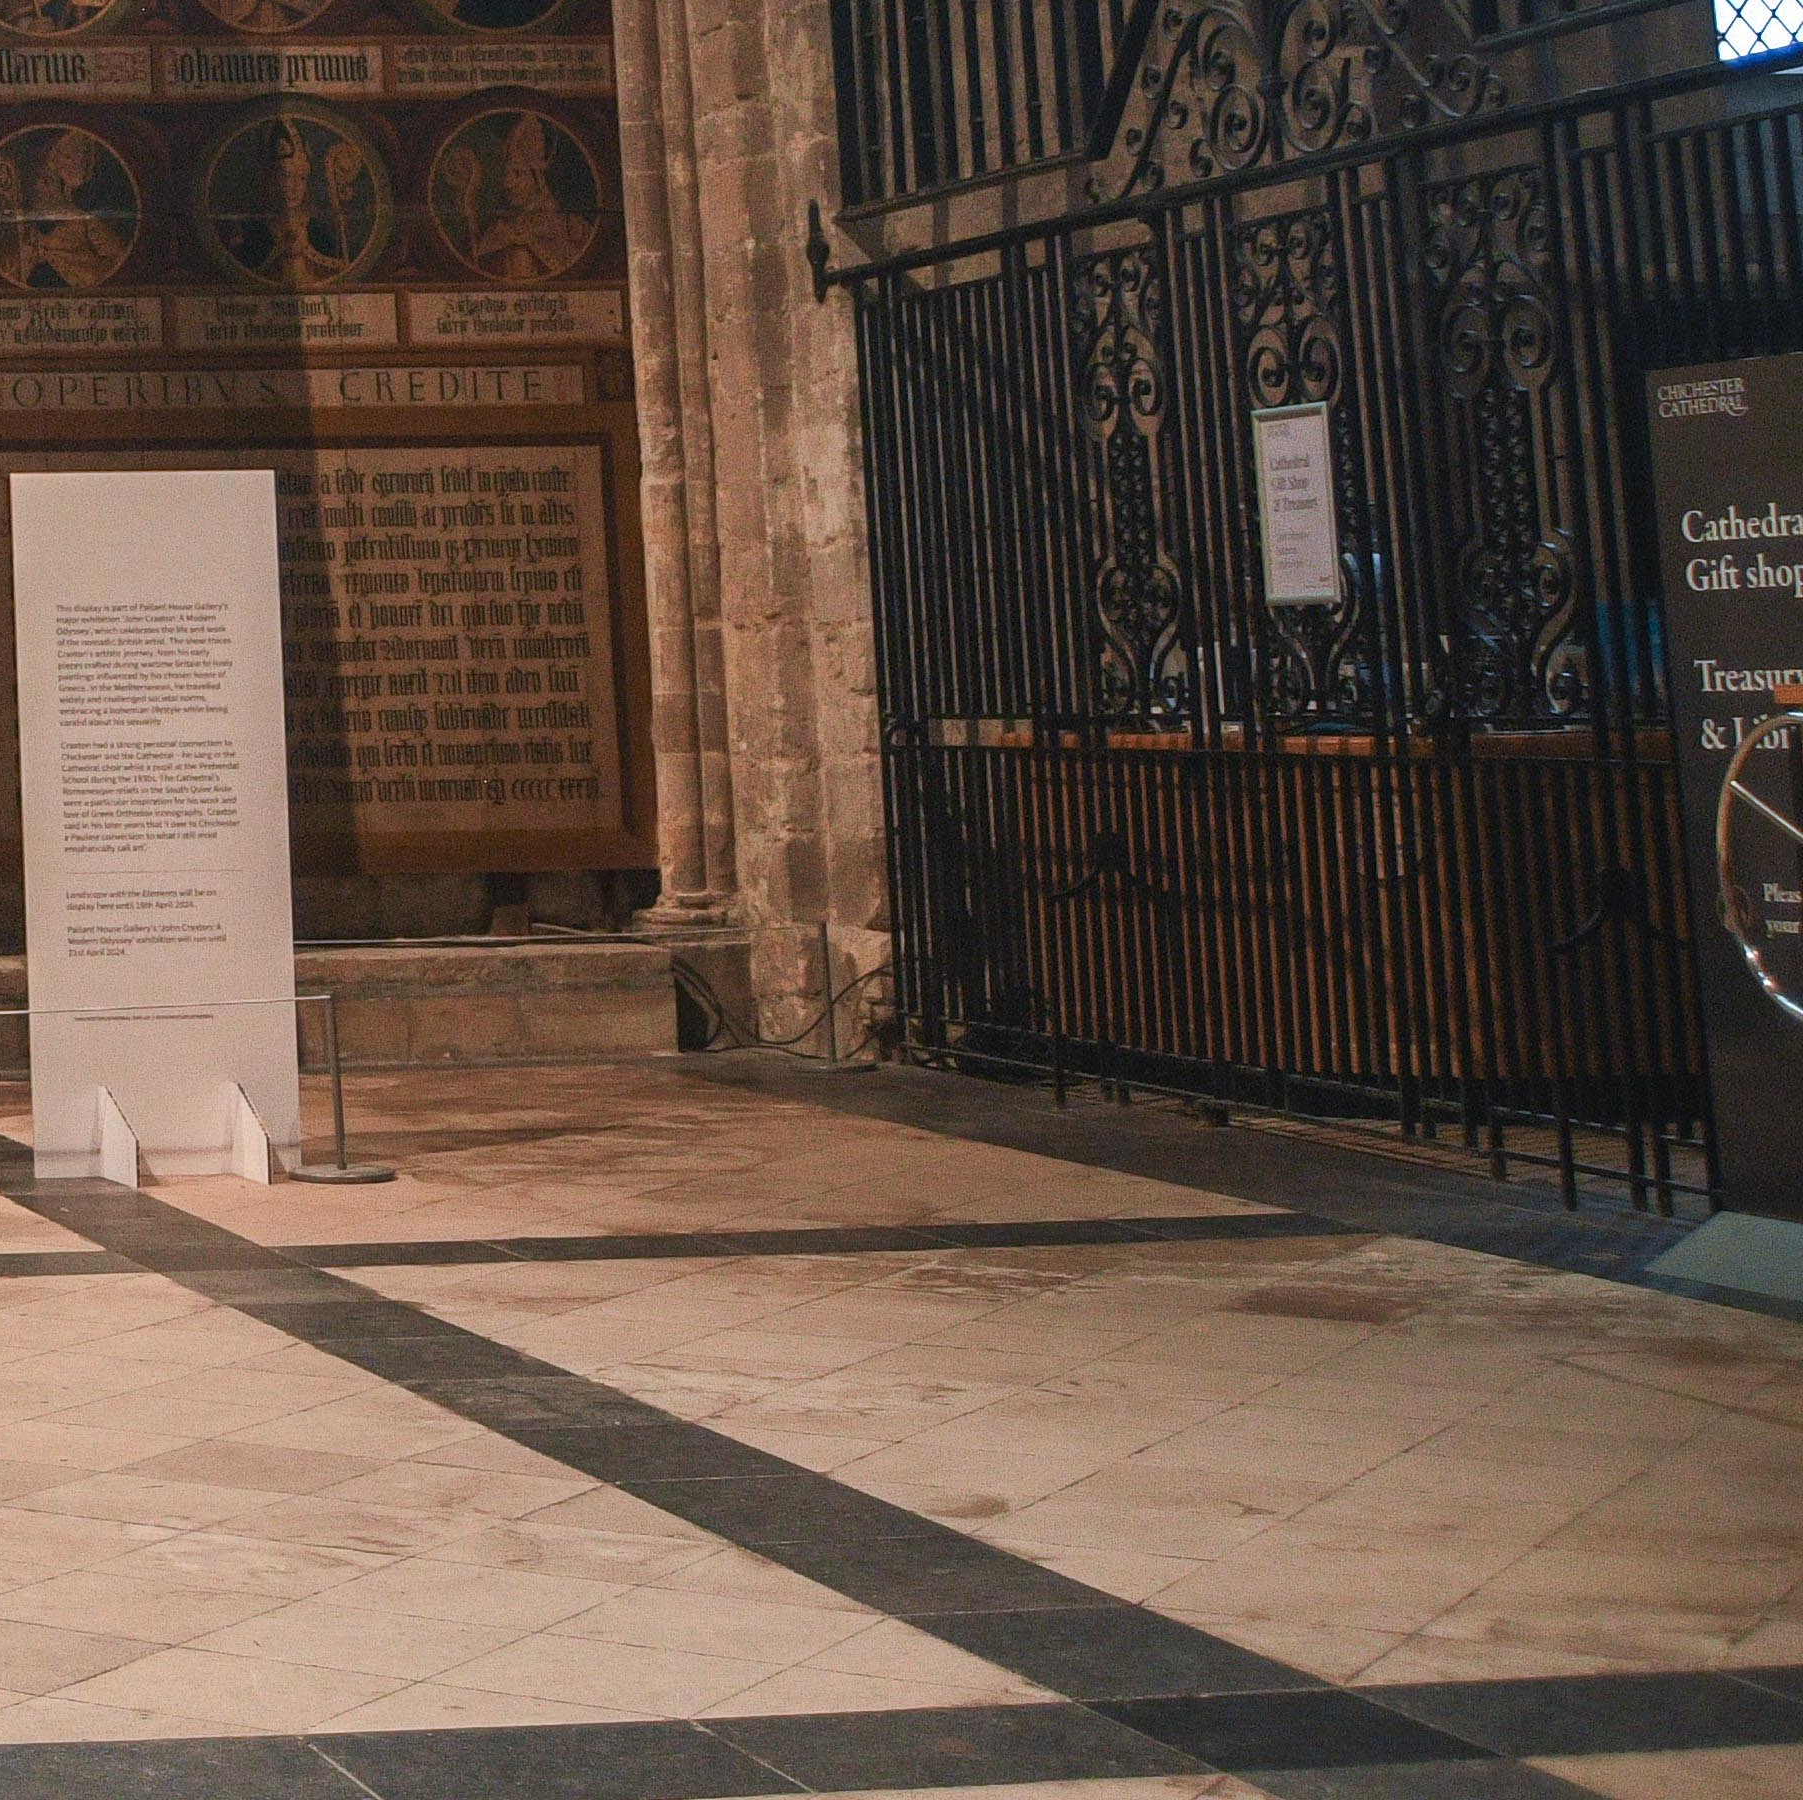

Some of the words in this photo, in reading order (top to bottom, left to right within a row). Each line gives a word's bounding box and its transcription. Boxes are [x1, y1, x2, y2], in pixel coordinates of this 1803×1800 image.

[337, 368, 544, 405] CREDITE
[1657, 378, 1746, 401] CHICHESTER
[1658, 395, 1750, 418] CATHEDRAL
[1685, 554, 1742, 593] Gift
[1700, 716, 1728, 749] &
[1762, 881, 1803, 903] Pleas
